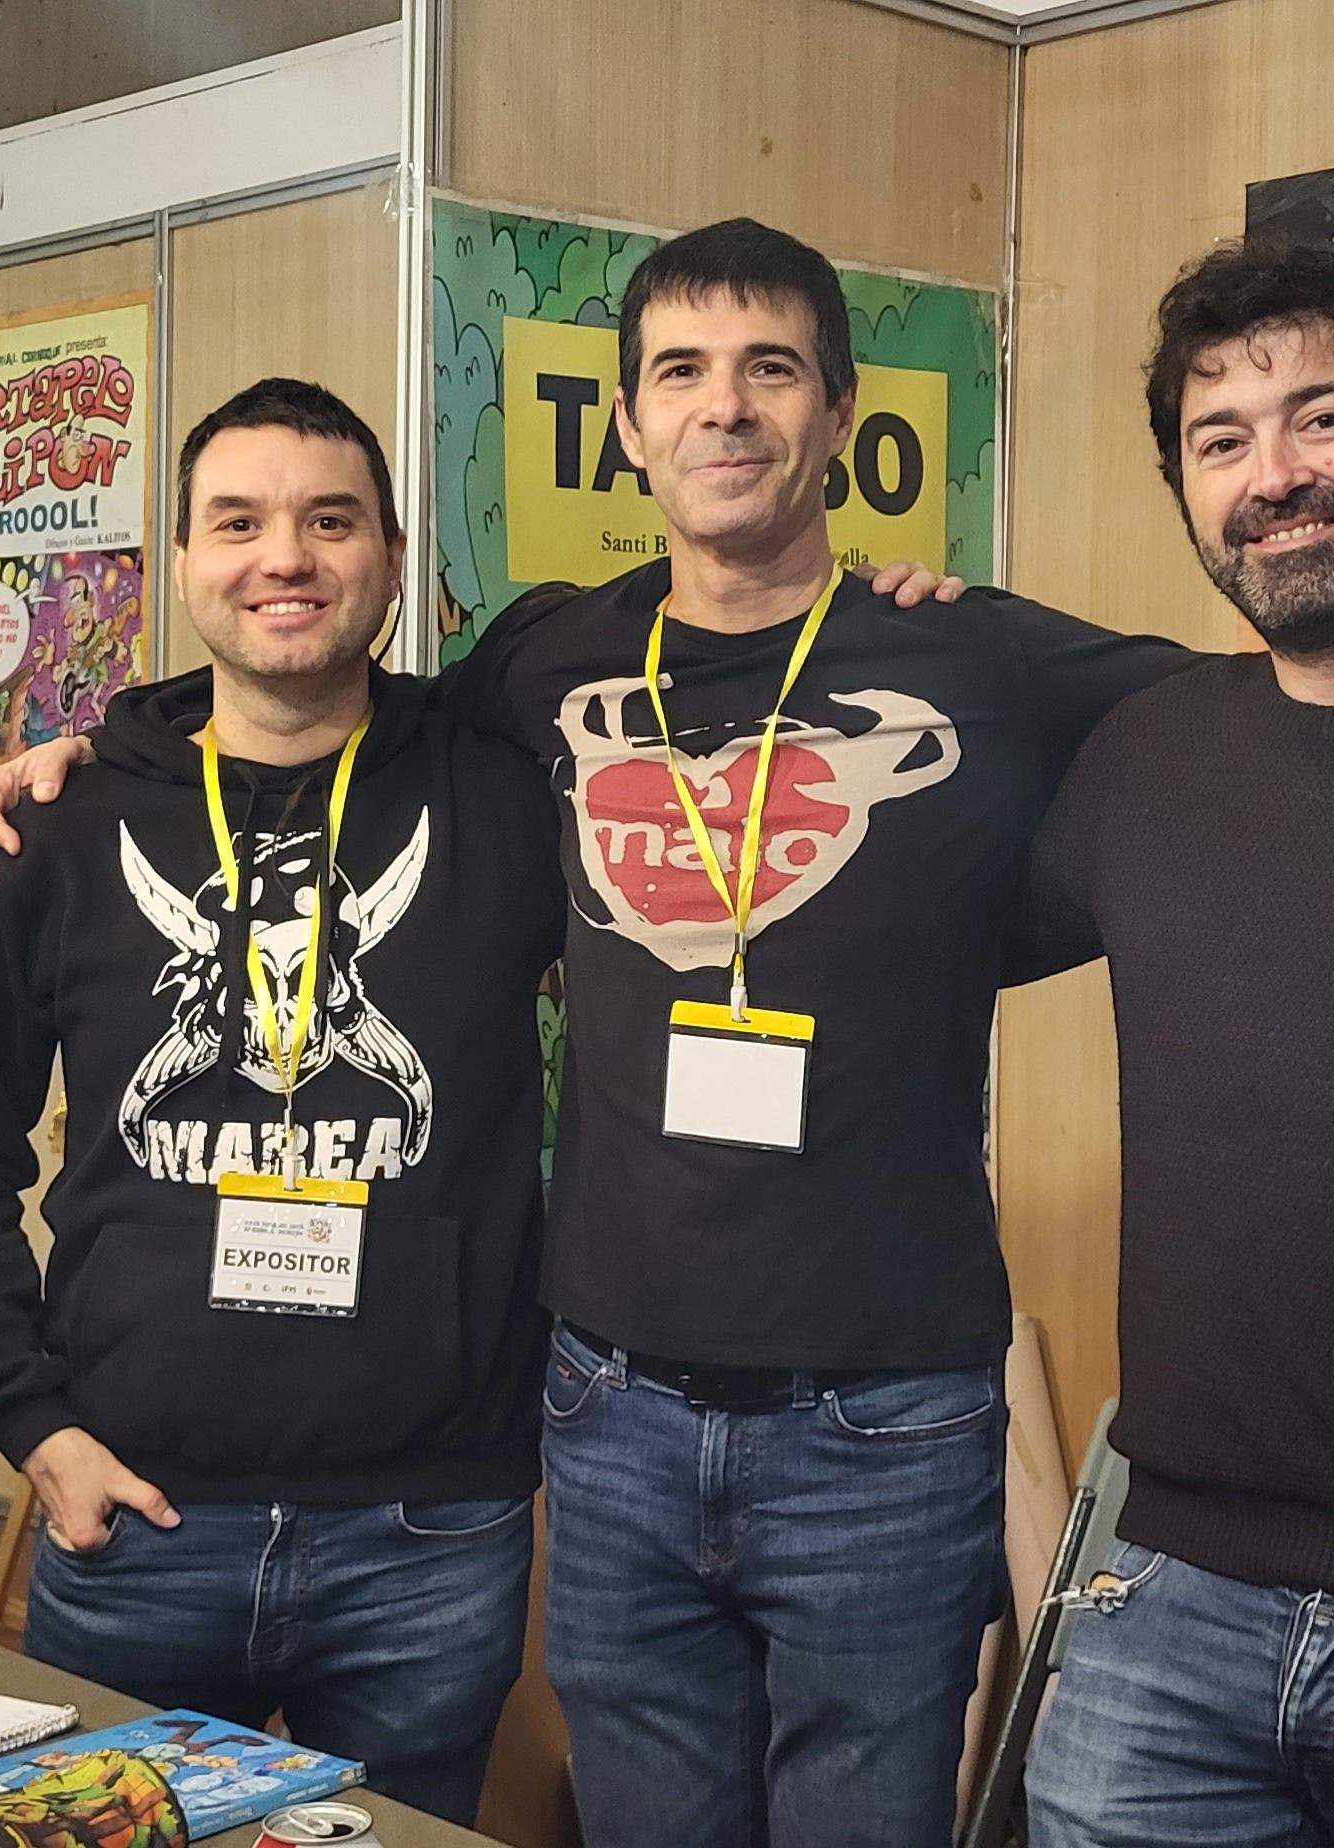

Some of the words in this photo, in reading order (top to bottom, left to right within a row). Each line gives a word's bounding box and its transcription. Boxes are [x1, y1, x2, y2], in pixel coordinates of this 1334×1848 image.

[602, 531, 647, 553] Santi
[147, 1117, 405, 1183] MAREA
[223, 1249, 351, 1275] EXPOSITOR
